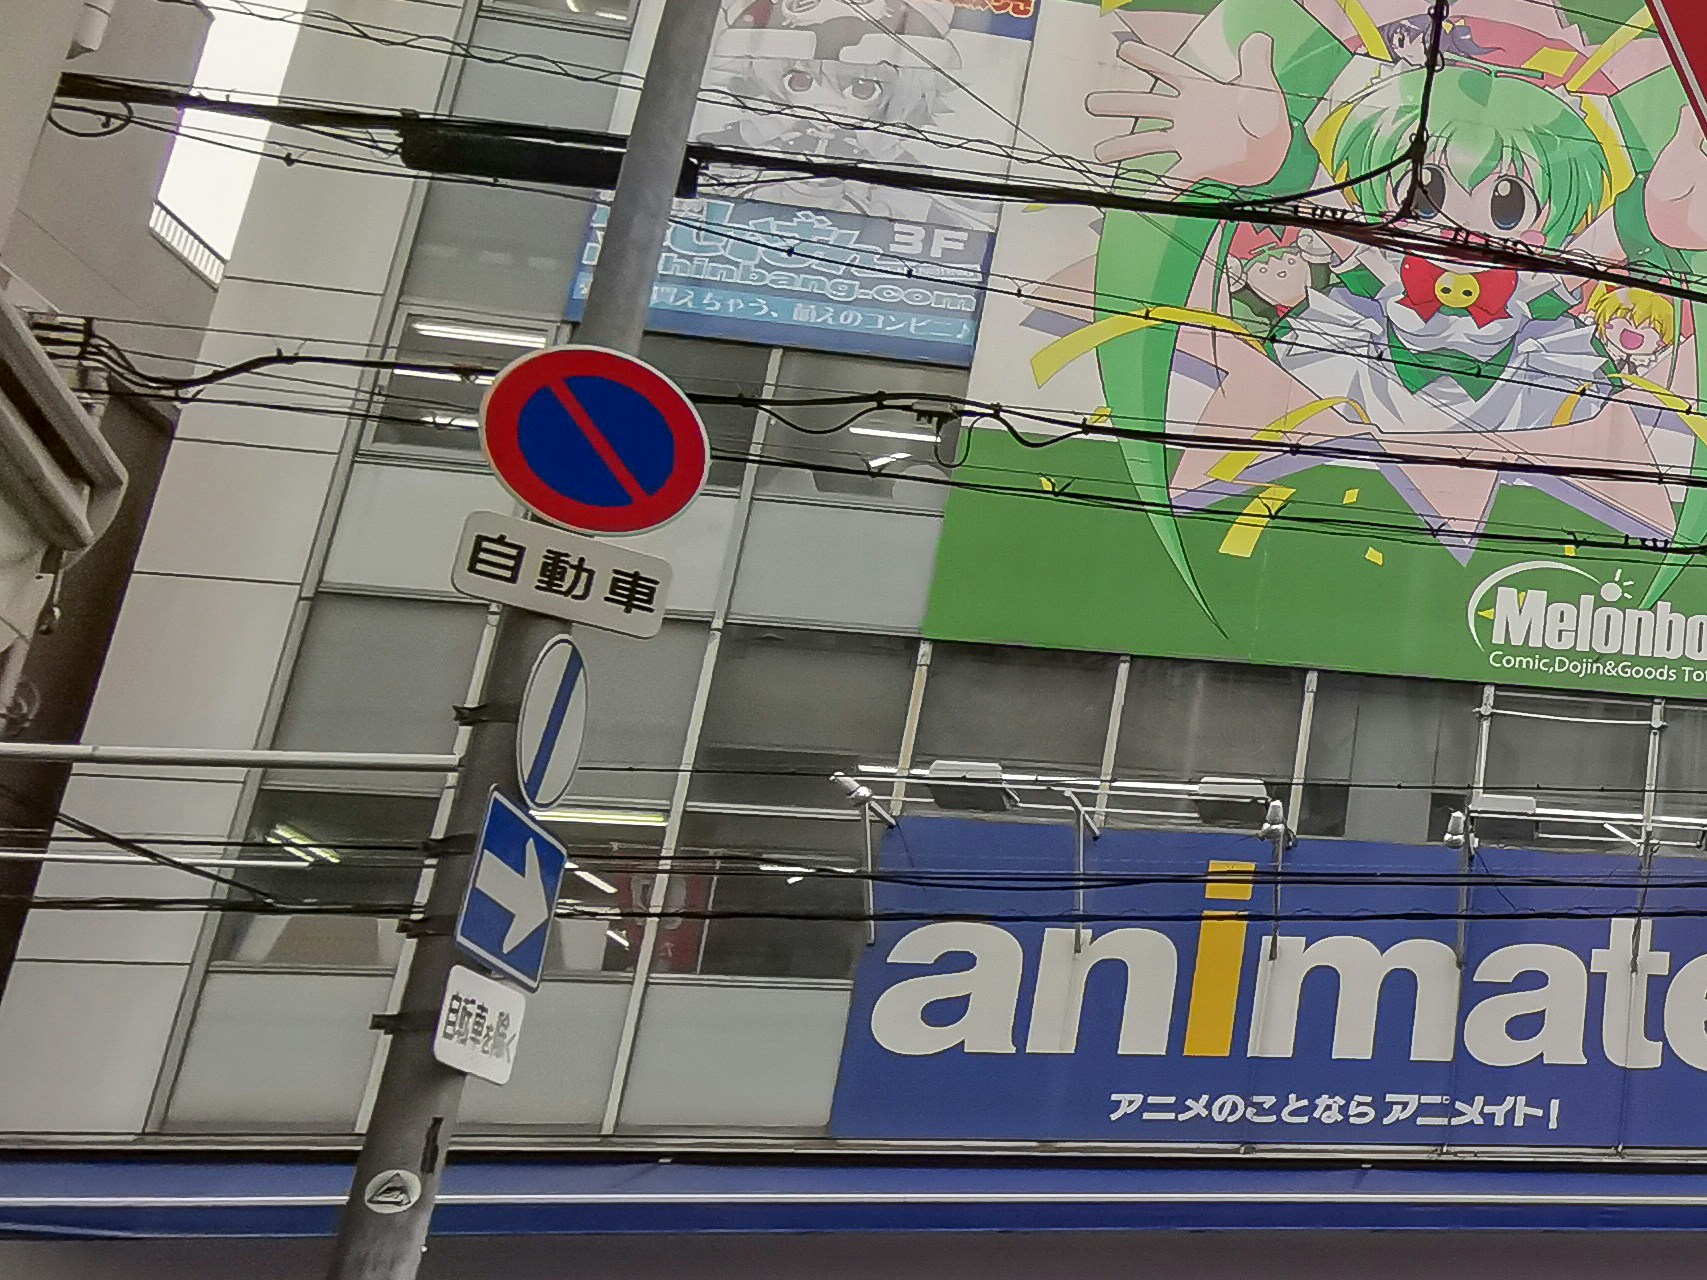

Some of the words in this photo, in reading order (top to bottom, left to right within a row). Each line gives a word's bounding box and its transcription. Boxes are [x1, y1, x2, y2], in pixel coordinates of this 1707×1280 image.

[887, 222, 969, 259] 3F
[466, 533, 662, 614] 自動車
